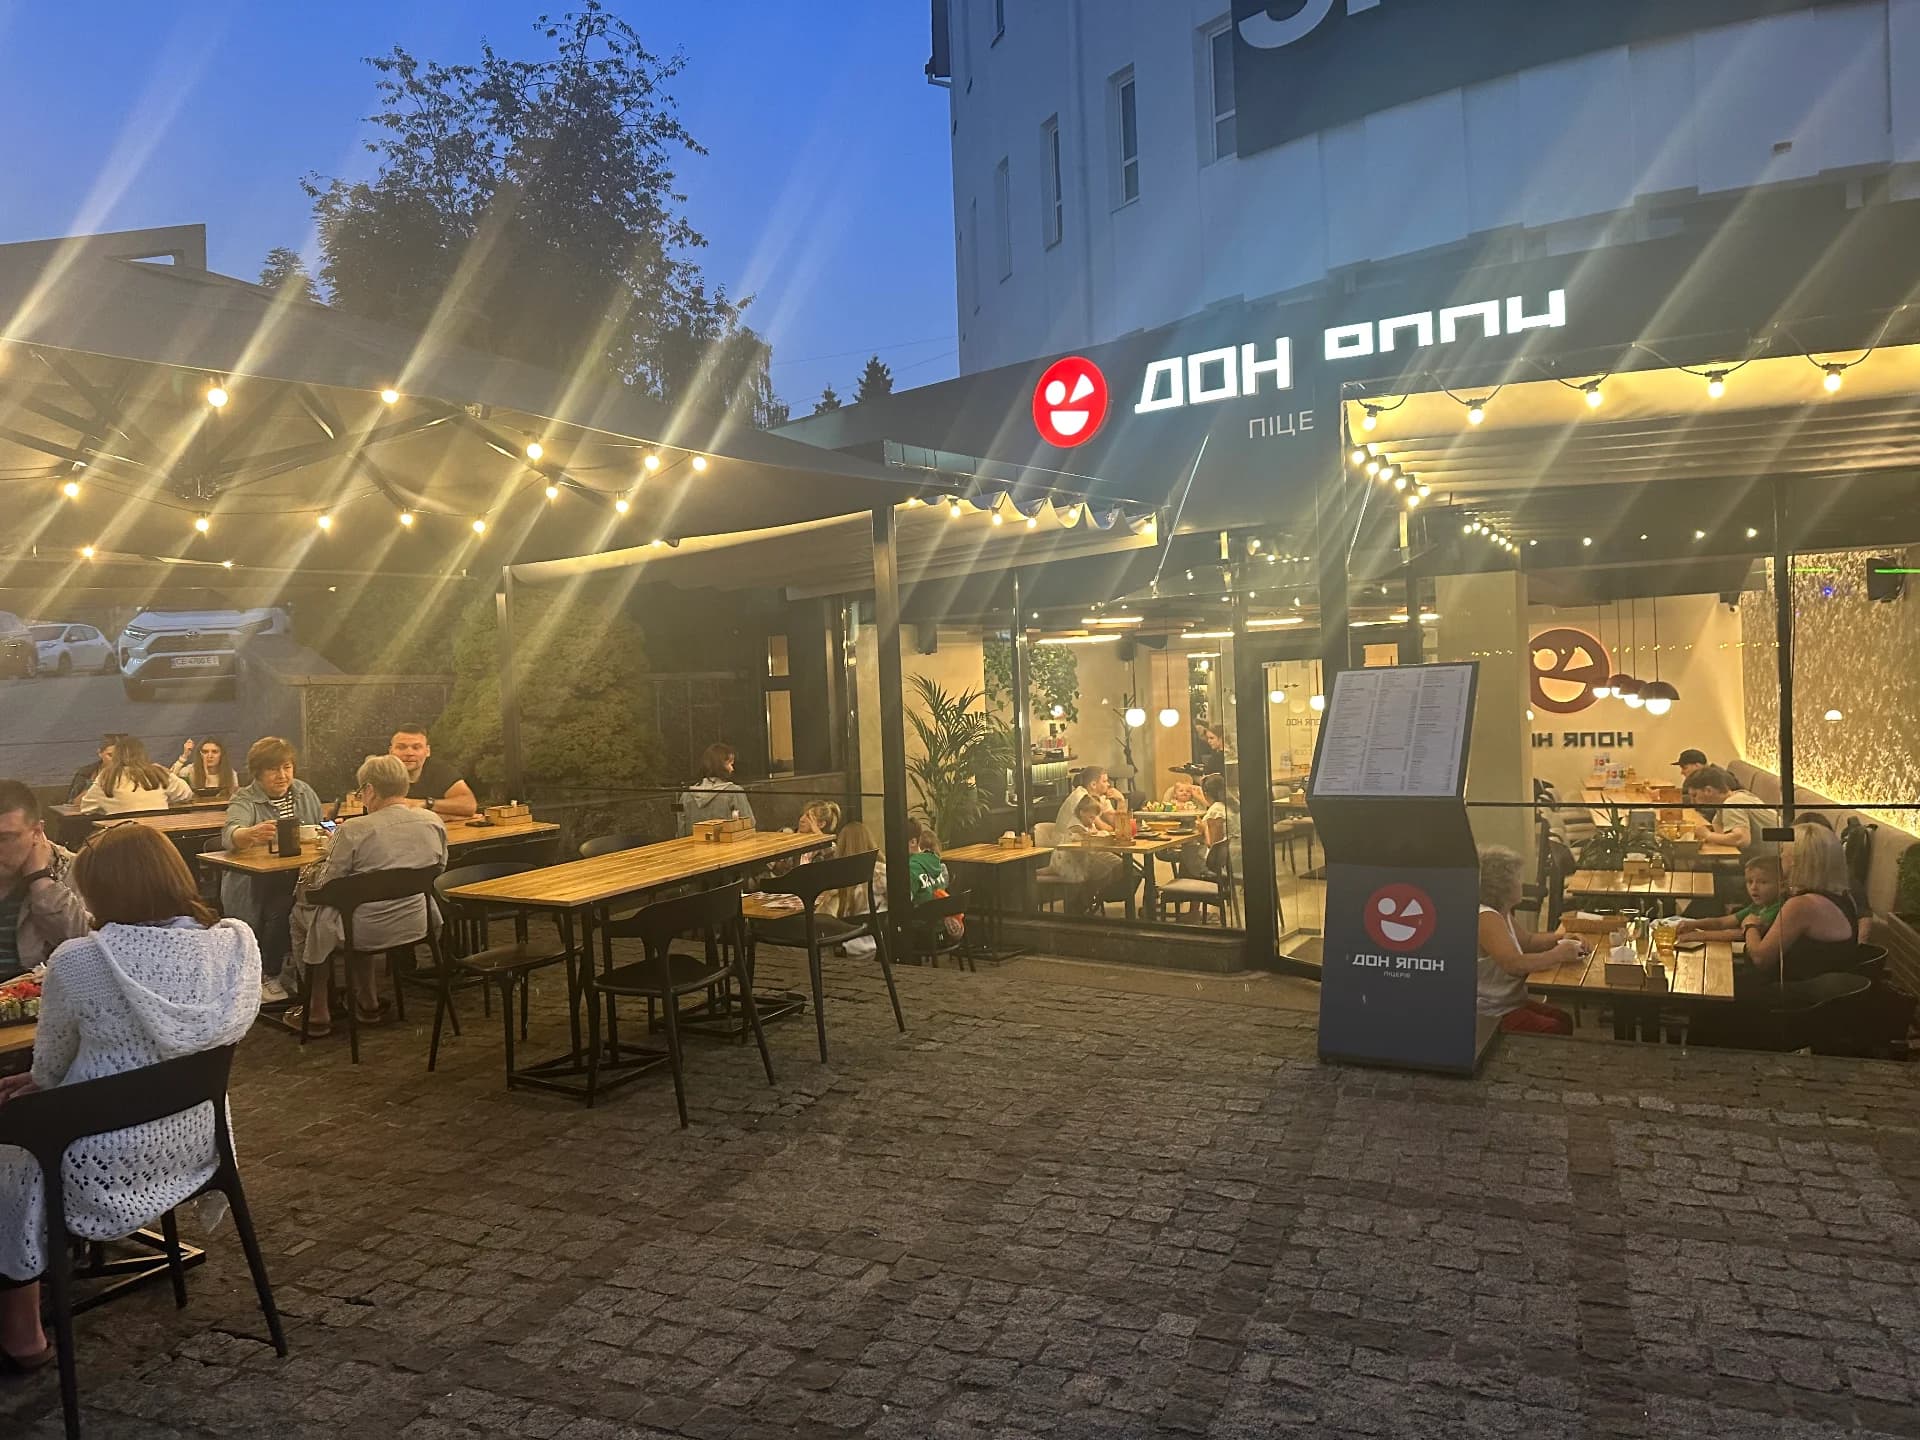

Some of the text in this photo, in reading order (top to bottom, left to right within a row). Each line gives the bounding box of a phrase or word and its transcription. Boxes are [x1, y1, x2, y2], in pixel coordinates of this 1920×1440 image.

[1134, 336, 1292, 414] ДОН
[1563, 731, 1634, 747] ЯПОН
[1352, 954, 1445, 972] ДОН ЯПОН
